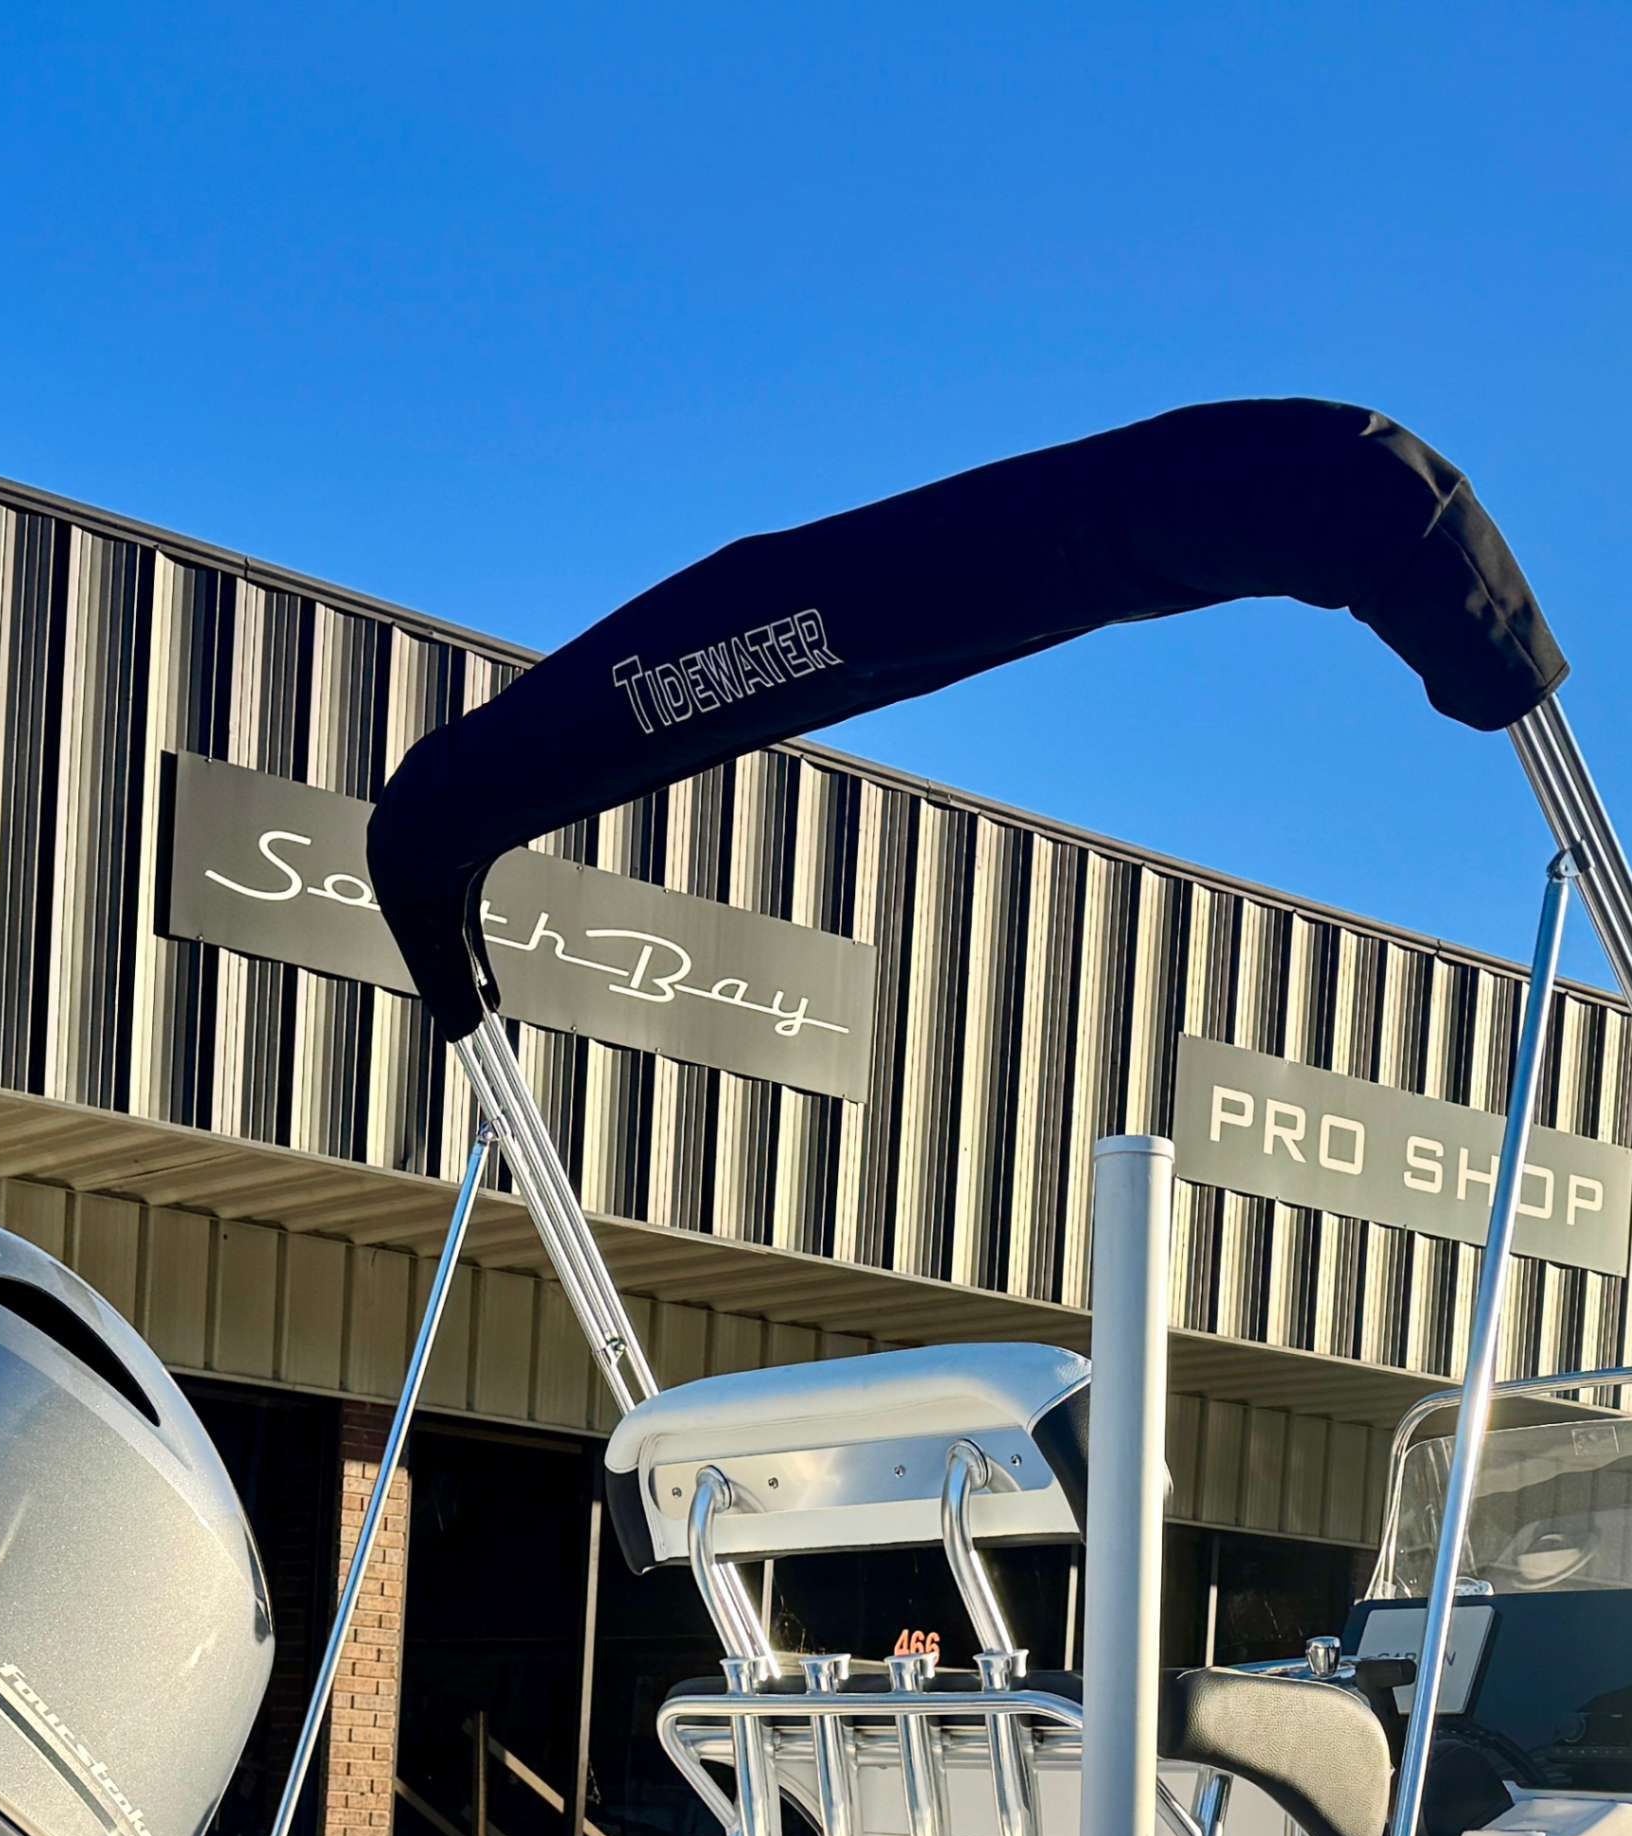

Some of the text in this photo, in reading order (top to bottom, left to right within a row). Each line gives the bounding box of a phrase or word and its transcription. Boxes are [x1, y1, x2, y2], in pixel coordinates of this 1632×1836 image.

[612, 608, 845, 734] TIDEWATER
[205, 830, 849, 1036] Soth Bay
[1209, 1084, 1604, 1226] PRO SHOP
[894, 1628, 940, 1664] 466
